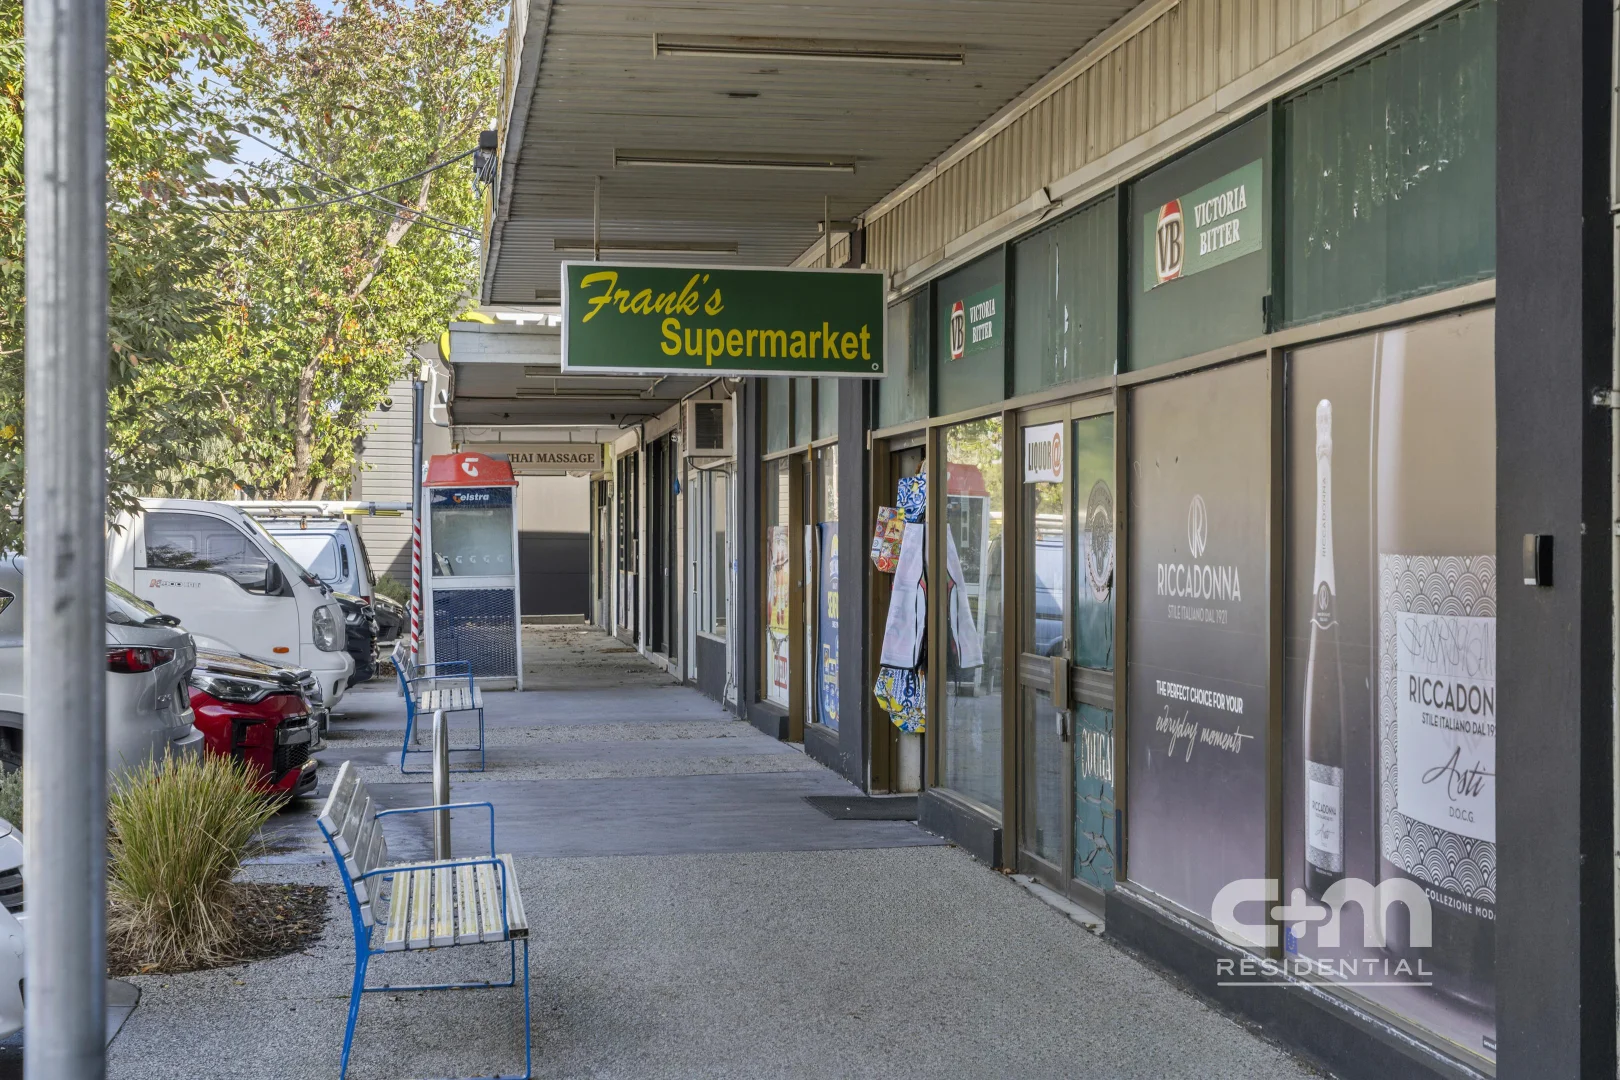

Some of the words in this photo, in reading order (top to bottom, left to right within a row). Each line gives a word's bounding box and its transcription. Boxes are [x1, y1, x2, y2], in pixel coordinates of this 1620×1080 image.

[1194, 185, 1248, 229] VICTORIA
[1158, 220, 1181, 273] VB
[1199, 218, 1241, 256] BITTER
[580, 271, 725, 323] Frank's
[969, 298, 996, 324] VICTORIA
[660, 317, 871, 366] Supermarket
[951, 314, 964, 352] VB
[972, 320, 993, 344] BITTER
[537, 453, 595, 463] MASSAGE
[452, 493, 490, 503] Telstra
[1157, 563, 1241, 602] RICCADONNA
[1167, 604, 1181, 620] STILE
[1181, 605, 1204, 622] ITALIANO
[1204, 608, 1216, 623] DAL
[1156, 679, 1167, 697] THE
[1166, 682, 1190, 702] PERFECT
[1189, 687, 1213, 708] CHOICE
[1212, 692, 1226, 711] FOR
[1225, 695, 1243, 715] YOUR
[1409, 675, 1495, 717] RICCADON
[1156, 704, 1199, 763] everyday
[1200, 725, 1254, 754] moments
[1421, 712, 1439, 727] STILE
[1439, 715, 1472, 734] ITALIANO
[1472, 721, 1486, 736] DAL
[1486, 723, 1497, 737] 19
[1421, 745, 1496, 802] Asti
[1425, 887, 1473, 914] COLLEZIONE
